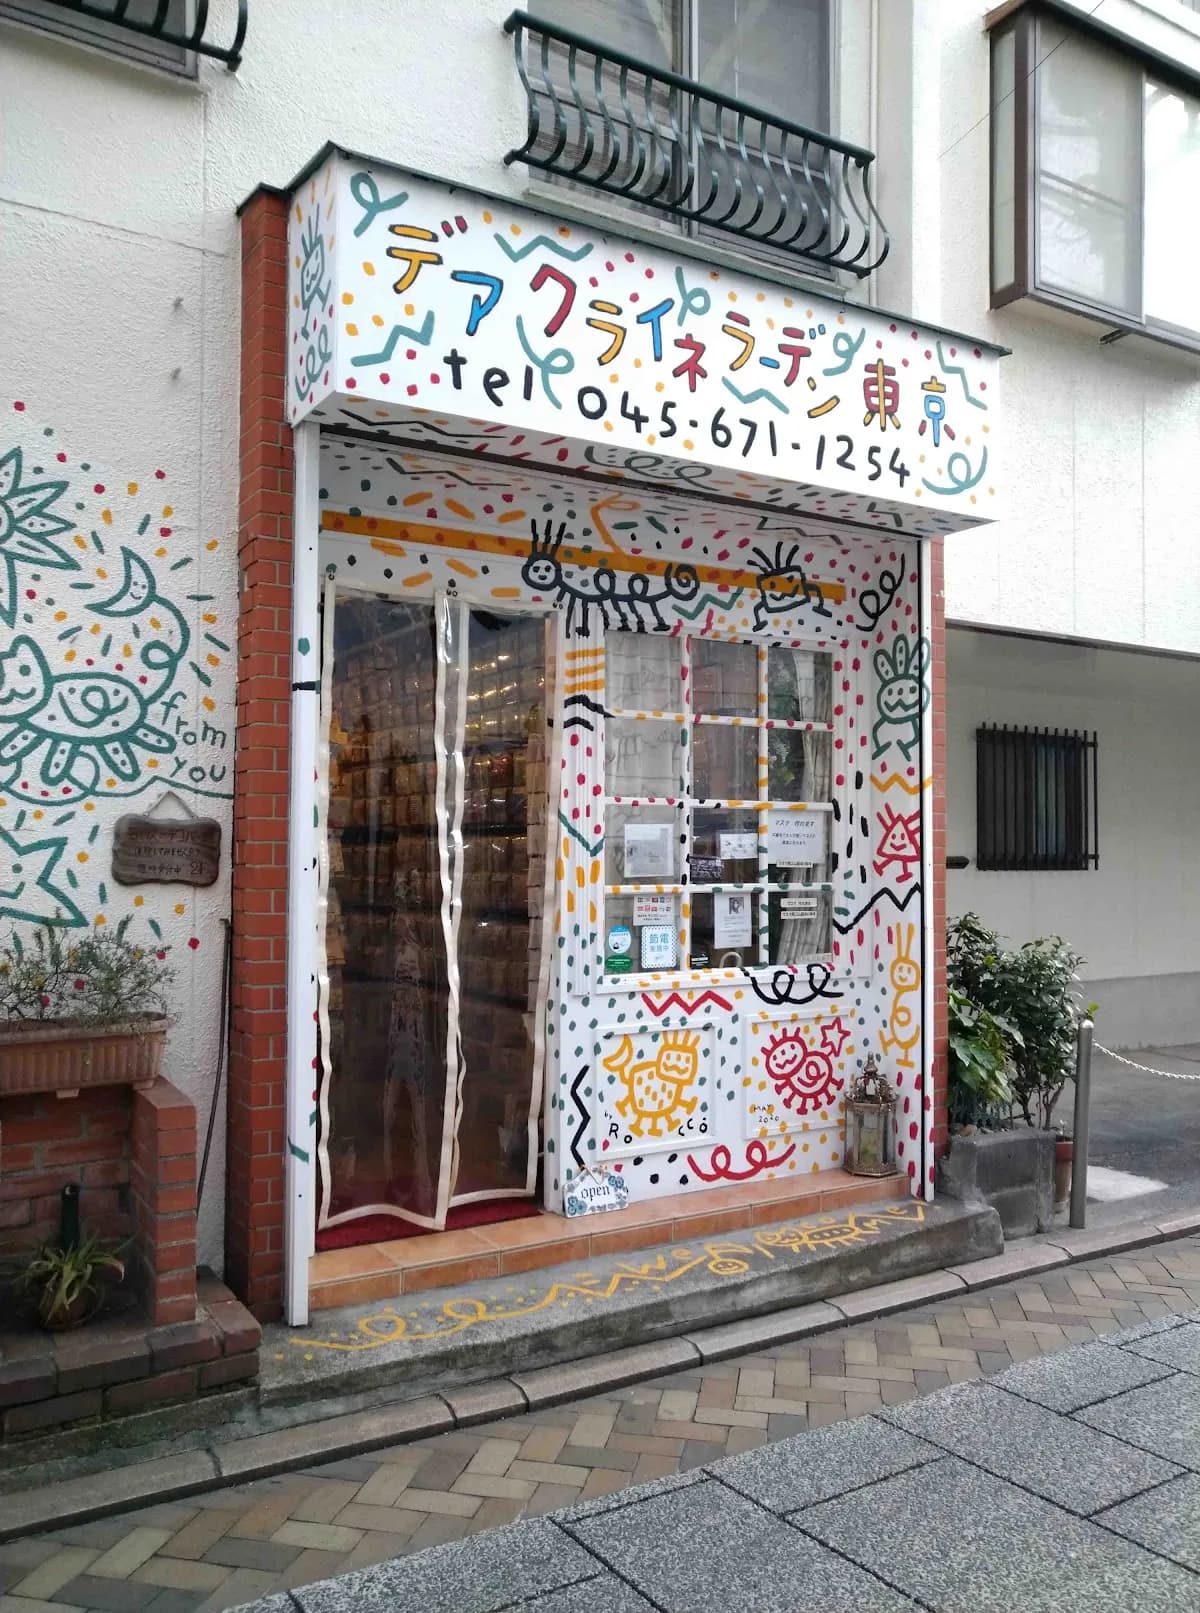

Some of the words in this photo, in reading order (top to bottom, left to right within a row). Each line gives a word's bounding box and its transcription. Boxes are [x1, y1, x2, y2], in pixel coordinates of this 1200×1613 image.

[443, 348, 534, 407] tel
[160, 691, 227, 749] from
[169, 756, 226, 783] you
[580, 1185, 611, 1202] open
